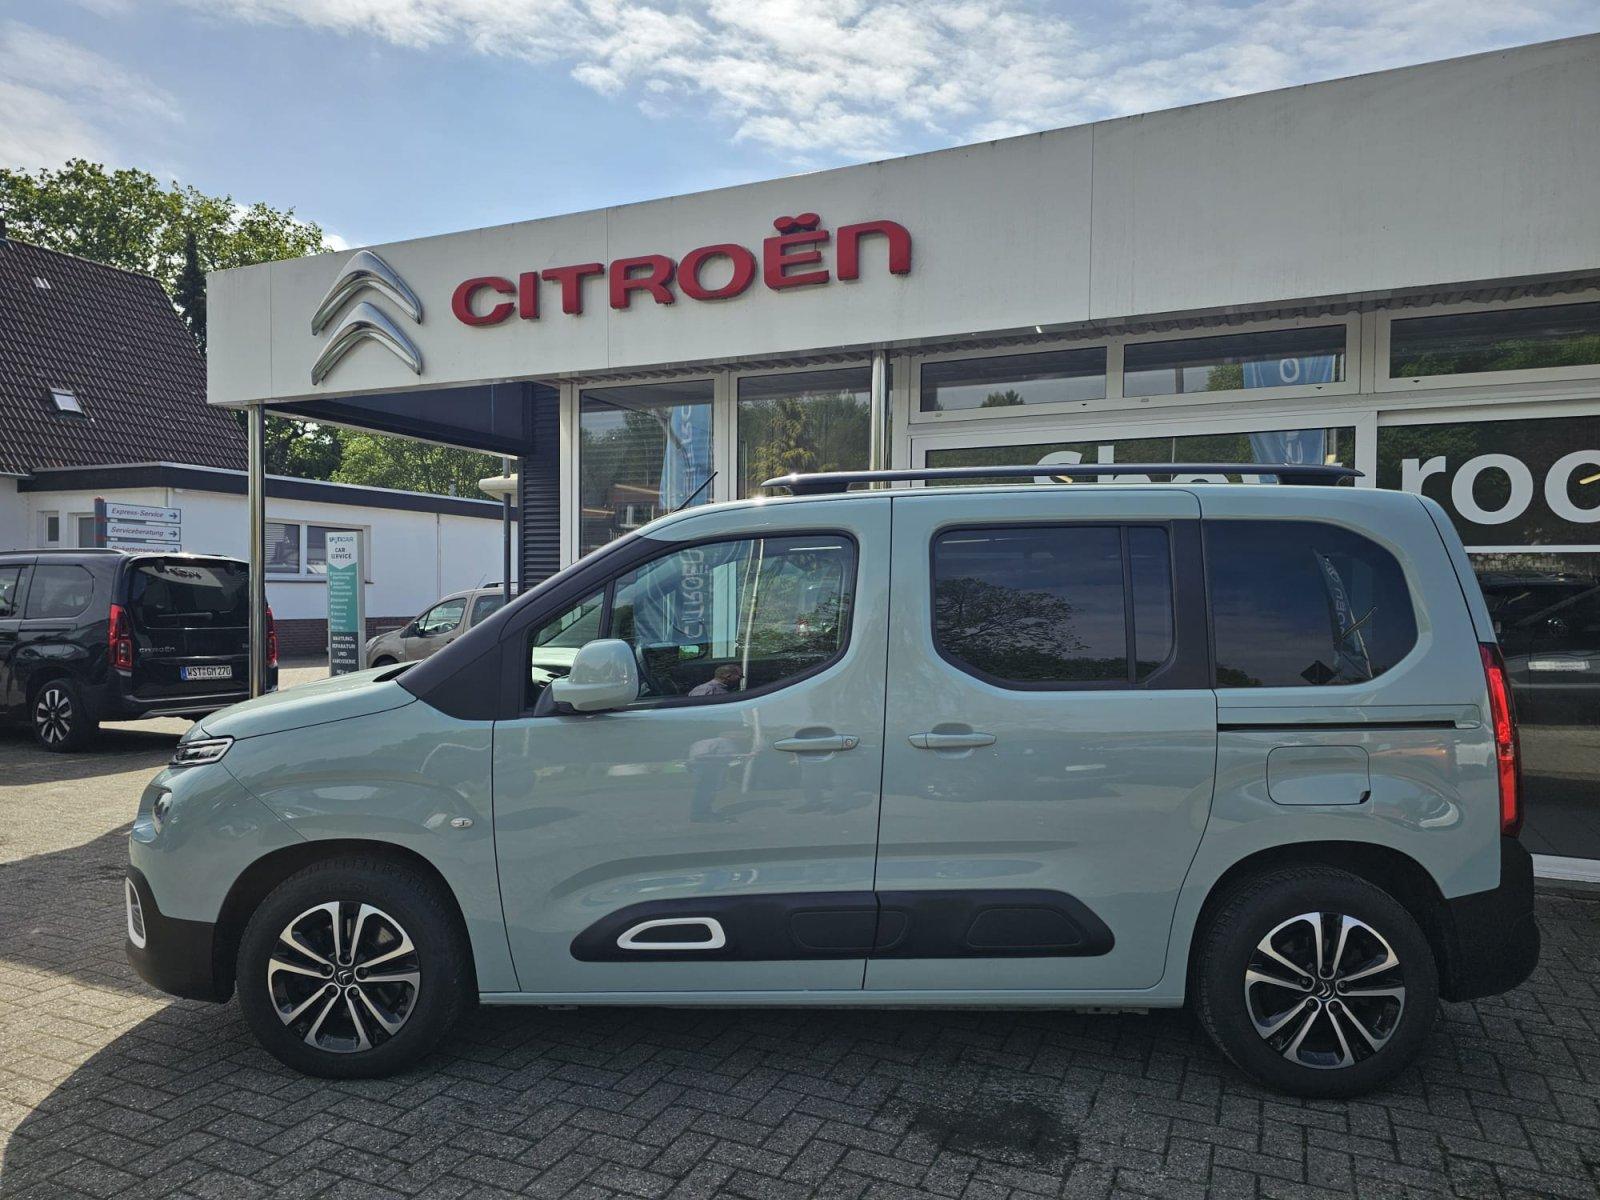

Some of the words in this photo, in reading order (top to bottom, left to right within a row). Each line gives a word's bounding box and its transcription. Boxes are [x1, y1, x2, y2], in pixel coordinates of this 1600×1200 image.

[451, 212, 912, 327] CITROËN
[111, 507, 164, 518] Express-Service
[111, 526, 164, 537] Serviceberatung
